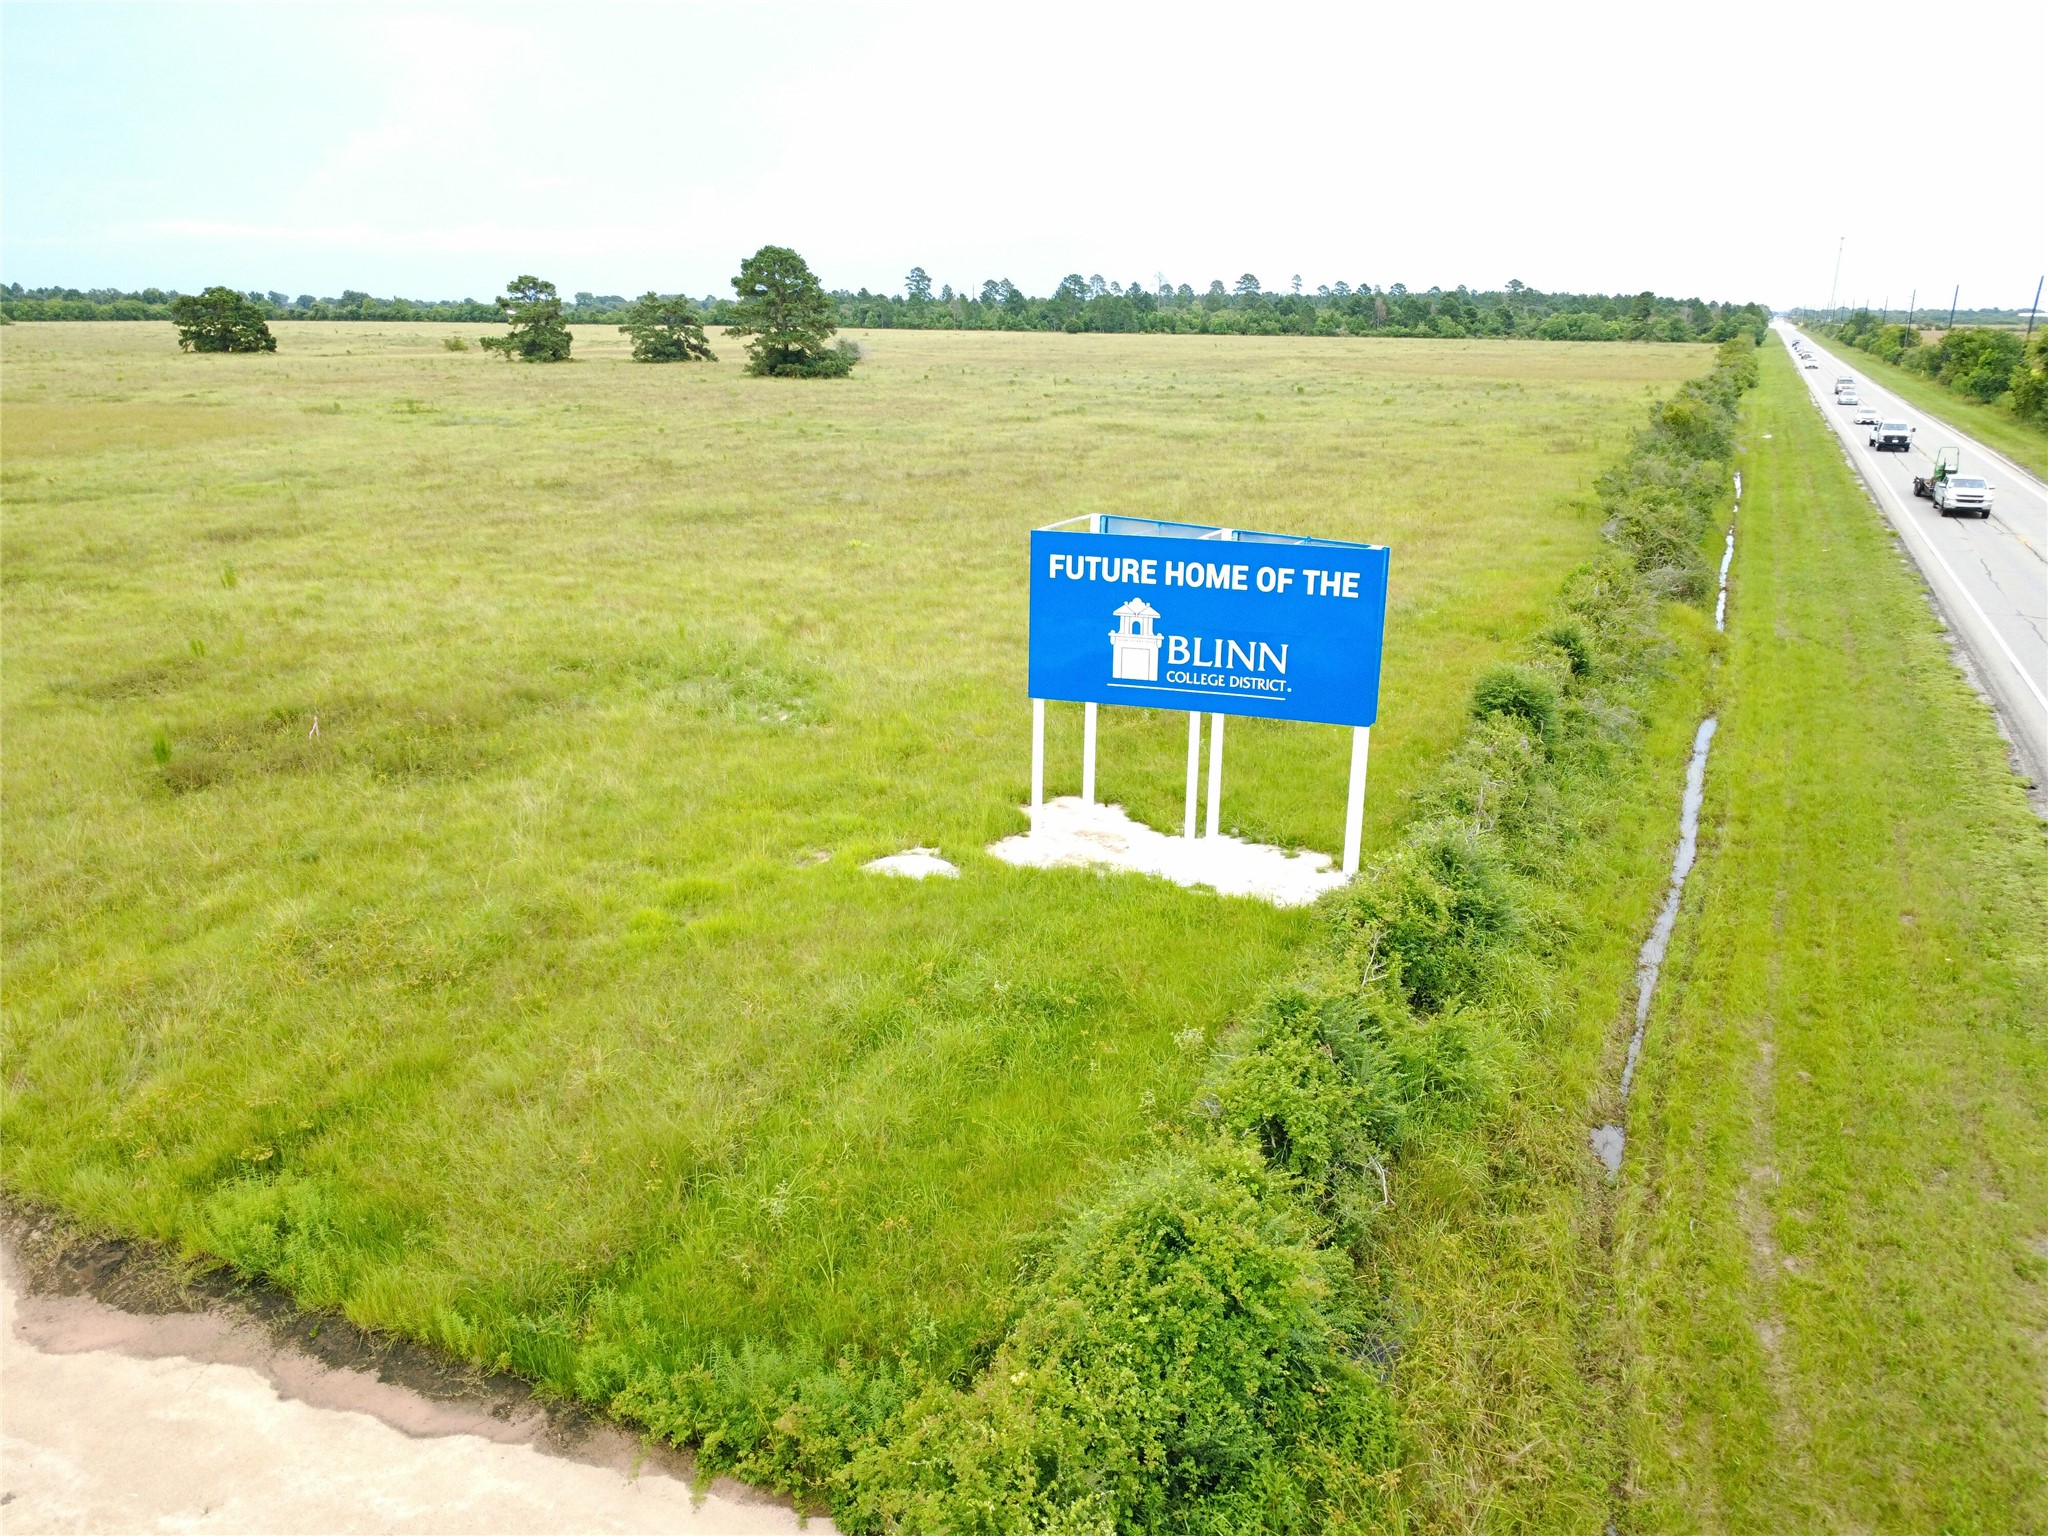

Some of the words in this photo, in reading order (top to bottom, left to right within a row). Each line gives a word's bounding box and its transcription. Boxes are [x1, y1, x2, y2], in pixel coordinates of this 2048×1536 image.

[1049, 553, 1158, 585] FUTURE
[1165, 561, 1249, 591] HOME
[1256, 566, 1295, 594] OF
[1302, 569, 1361, 599] THE
[1167, 635, 1289, 675] BLINN
[1166, 670, 1226, 687] COLLEGE
